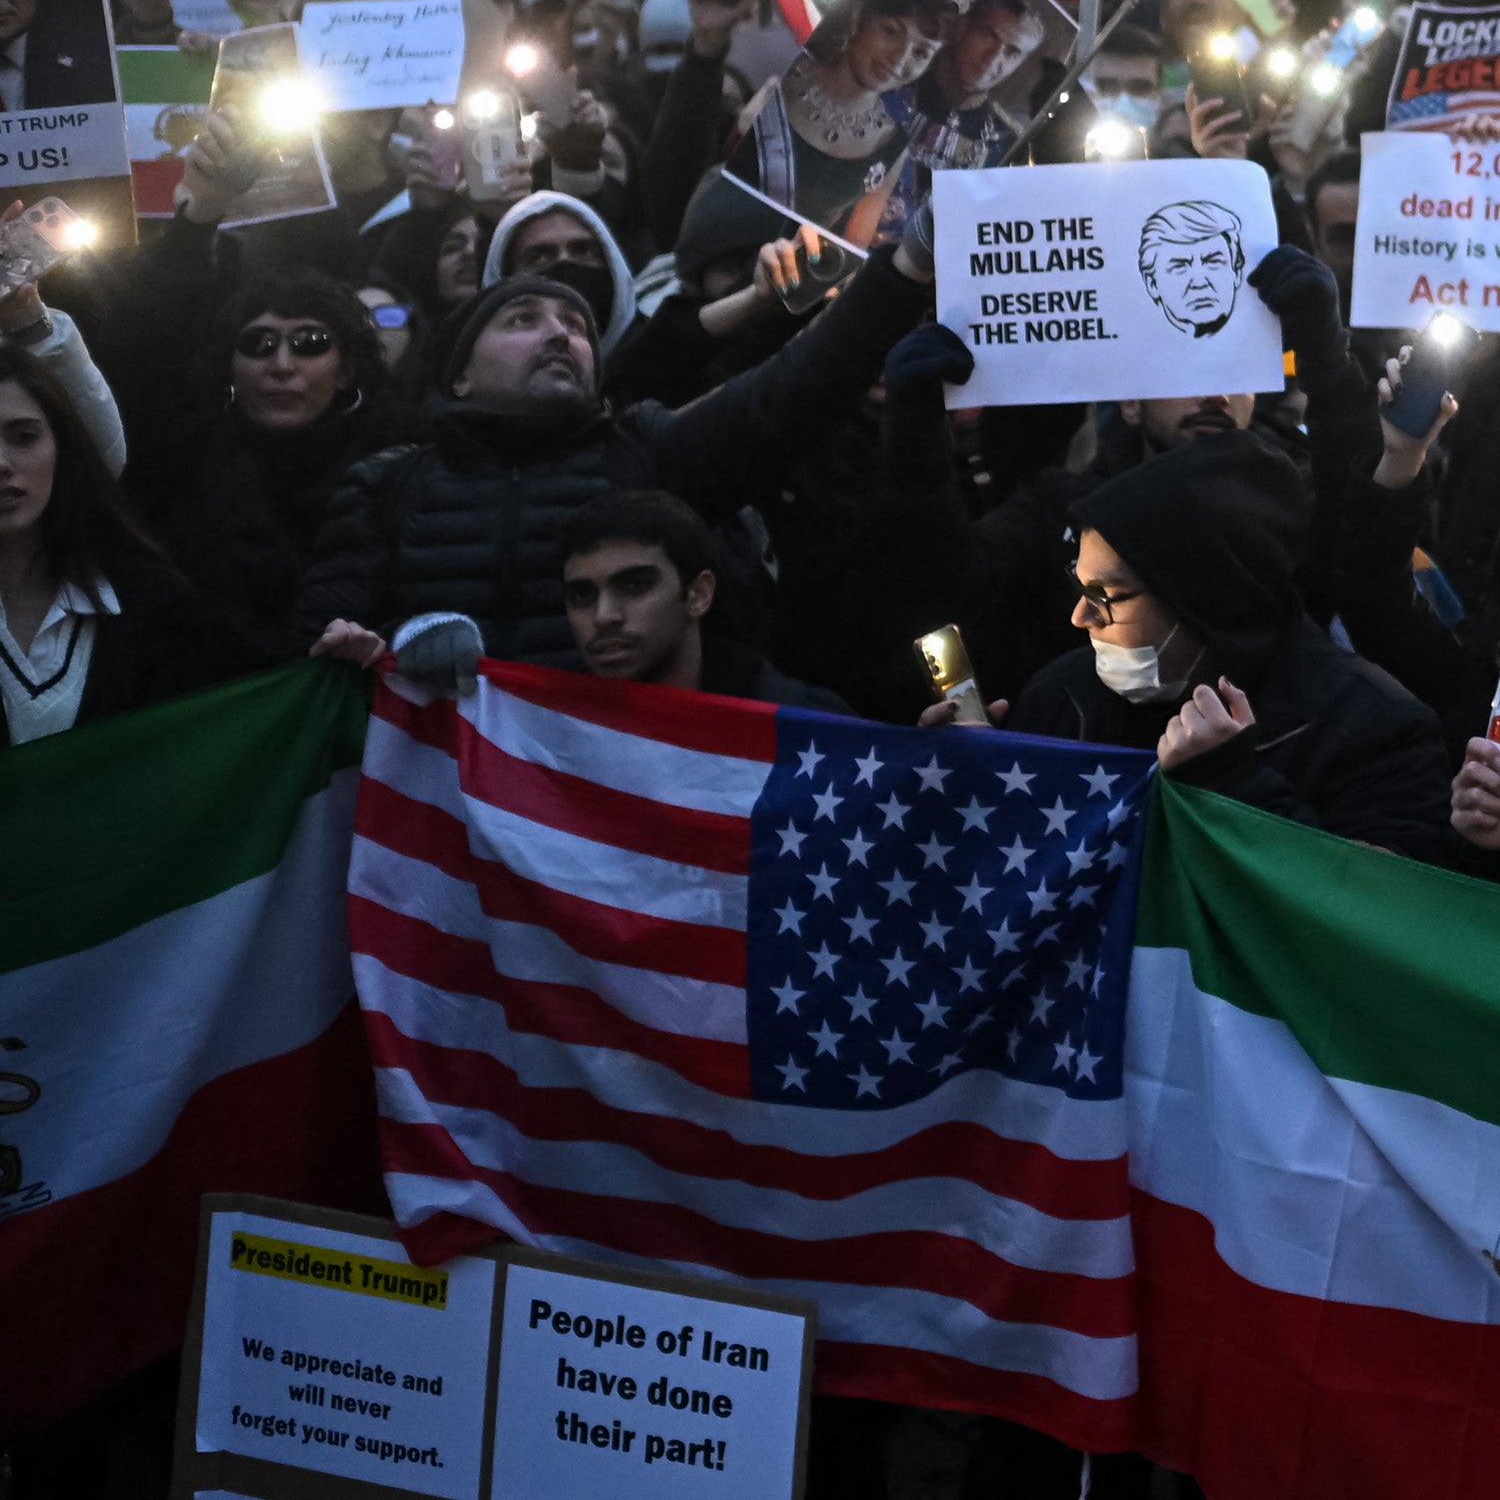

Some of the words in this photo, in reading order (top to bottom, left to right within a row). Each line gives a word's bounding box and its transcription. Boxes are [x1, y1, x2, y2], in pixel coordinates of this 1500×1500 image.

[18, 112, 90, 132] TRUMP
[18, 147, 70, 171] US!
[1400, 194, 1474, 220] dead
[976, 221, 1035, 246] END
[1040, 217, 1094, 242] THE
[970, 246, 1105, 277] MULLAHS
[1373, 234, 1458, 262] History
[1466, 237, 1487, 258] is
[980, 289, 1099, 317] DESERVE
[1408, 275, 1470, 306] Act
[968, 322, 1019, 346] THE
[1024, 317, 1119, 343] NOBEL.
[232, 1238, 353, 1285] President
[359, 1263, 448, 1305] Trump!
[529, 1299, 647, 1349] People
[656, 1325, 694, 1357] of
[702, 1331, 770, 1372] Iran
[242, 1337, 275, 1362] We
[280, 1348, 397, 1387] appreciate
[402, 1375, 443, 1397] and
[288, 1383, 325, 1407] will
[331, 1393, 392, 1421] never
[556, 1357, 637, 1401] have
[647, 1376, 733, 1419] done
[231, 1405, 297, 1437] forget
[301, 1423, 350, 1448] your
[354, 1436, 444, 1468] support.
[555, 1410, 636, 1453] their
[645, 1433, 727, 1472] part!
